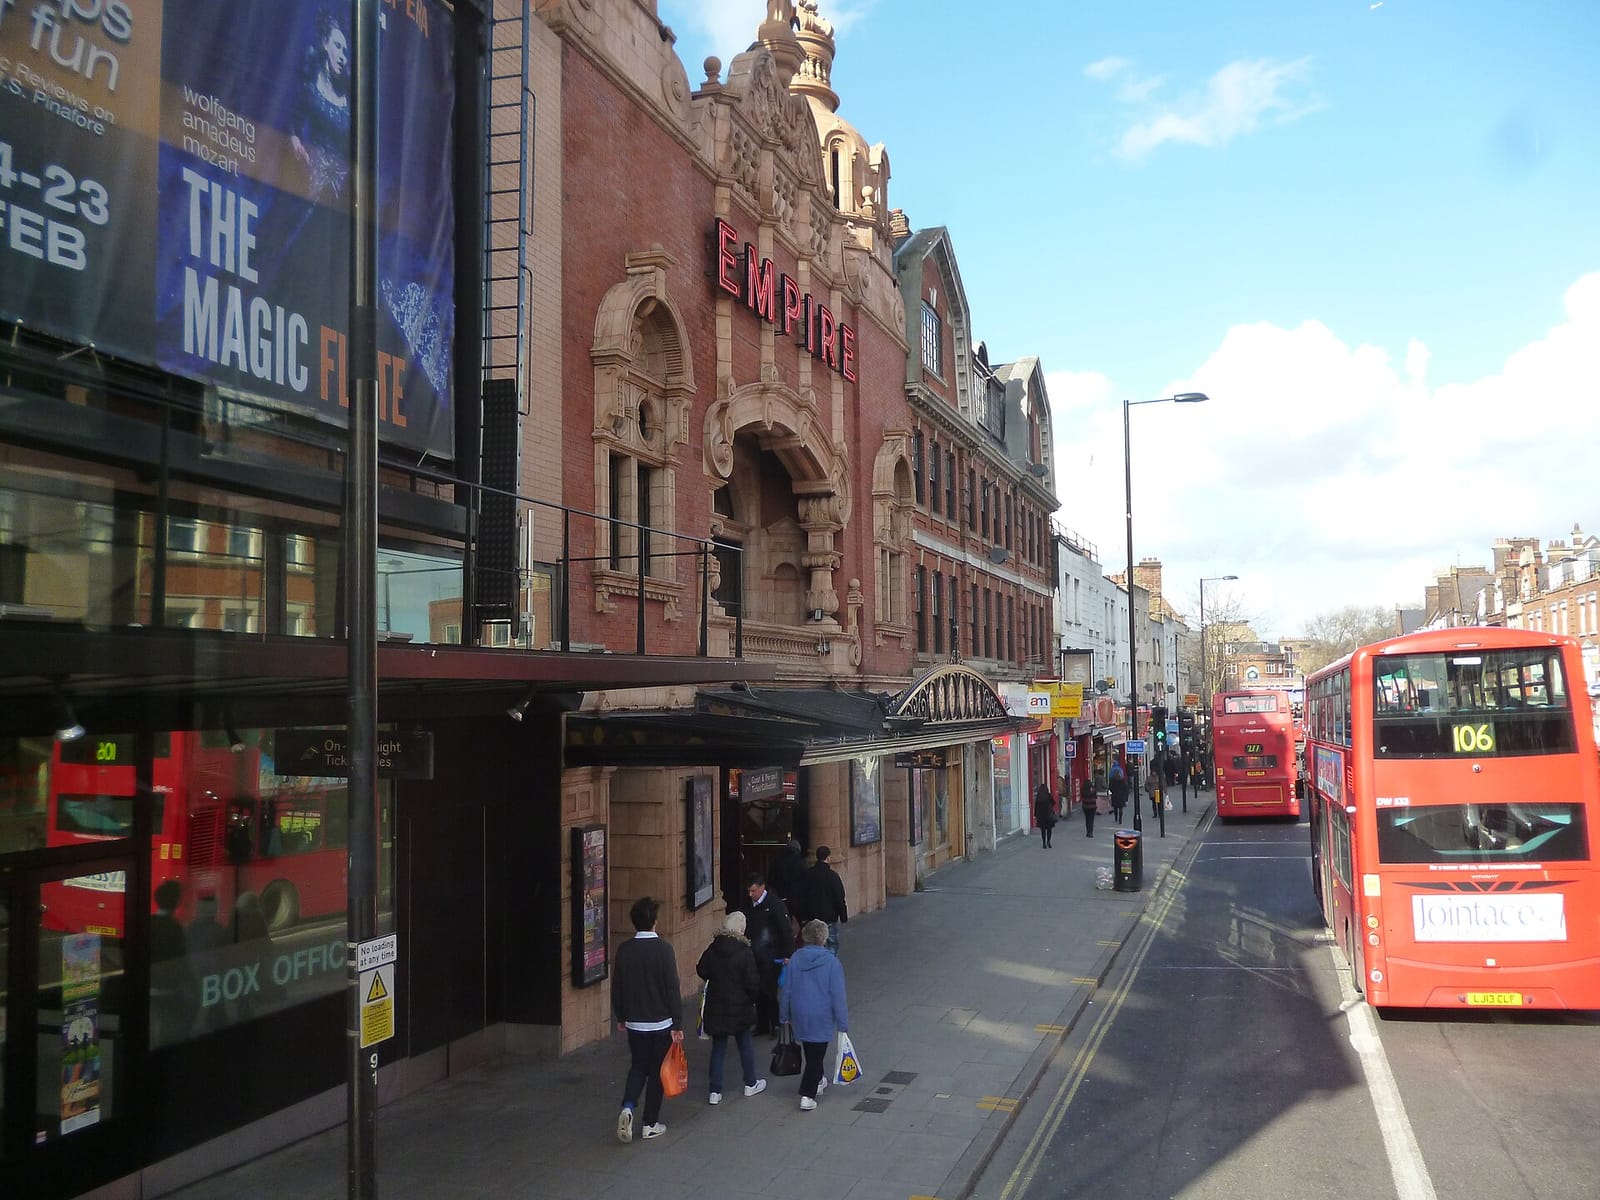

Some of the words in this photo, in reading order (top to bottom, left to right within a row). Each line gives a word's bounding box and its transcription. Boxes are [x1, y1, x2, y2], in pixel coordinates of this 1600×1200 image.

[31, 4, 119, 91] fun
[16, 62, 89, 112] Reviews
[94, 105, 115, 124] on
[33, 89, 105, 136] Pinafore
[183, 85, 255, 144] wolfgang
[182, 111, 256, 164] amadeus
[183, 134, 239, 178] mozart
[182, 167, 259, 284] THE
[715, 217, 857, 383] EMPIRE
[183, 266, 309, 393] MAGIC
[320, 325, 408, 428] FLTE
[1030, 697, 1048, 706] am
[1453, 724, 1494, 752] 106
[202, 962, 261, 1007] BOX
[273, 940, 346, 985] OFFIC
[360, 957, 367, 966] at
[368, 954, 379, 964] any
[381, 950, 395, 960] time
[361, 947, 371, 955] No
[372, 940, 394, 953] loading
[1474, 994, 1495, 1004] LJ13
[1497, 994, 1516, 1004] CLF
